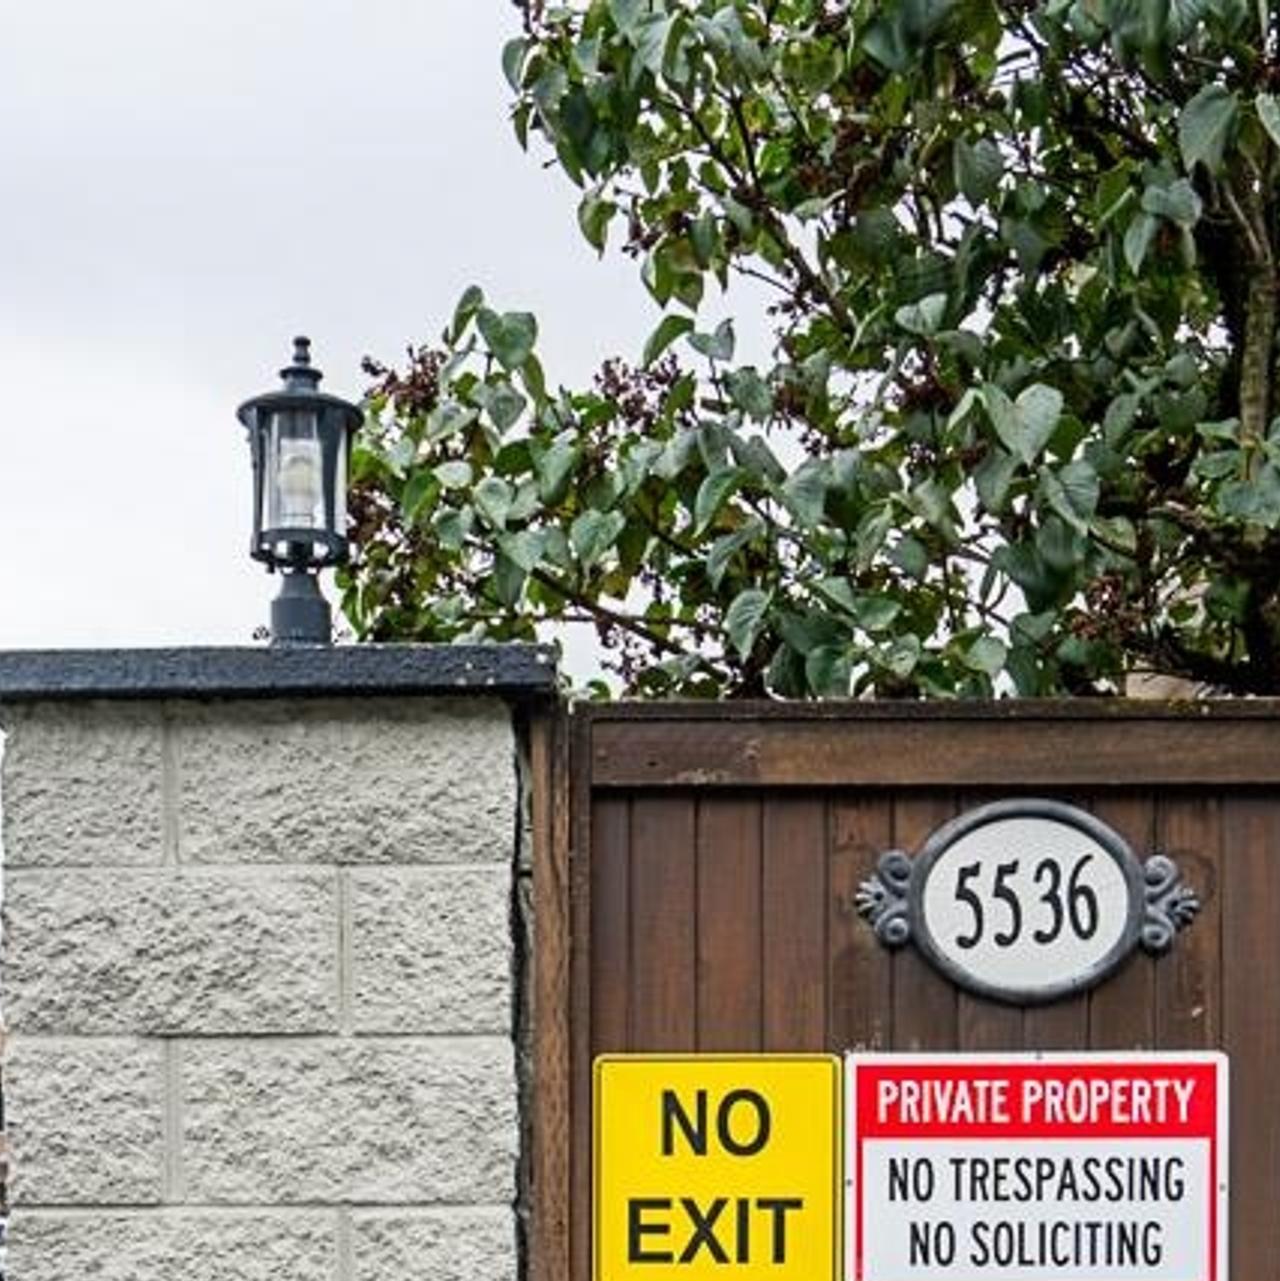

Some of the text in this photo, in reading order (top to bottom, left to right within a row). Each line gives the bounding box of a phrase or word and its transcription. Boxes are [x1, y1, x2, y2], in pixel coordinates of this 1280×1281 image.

[953, 854, 1100, 950] 5536
[661, 1088, 772, 1157] NO
[877, 1078, 1196, 1124] PRIVATE PROPERTY
[887, 1156, 1185, 1203] NO TRESPASSING
[627, 1197, 804, 1265] EXIT
[908, 1219, 1163, 1268] NO SOLICITING
